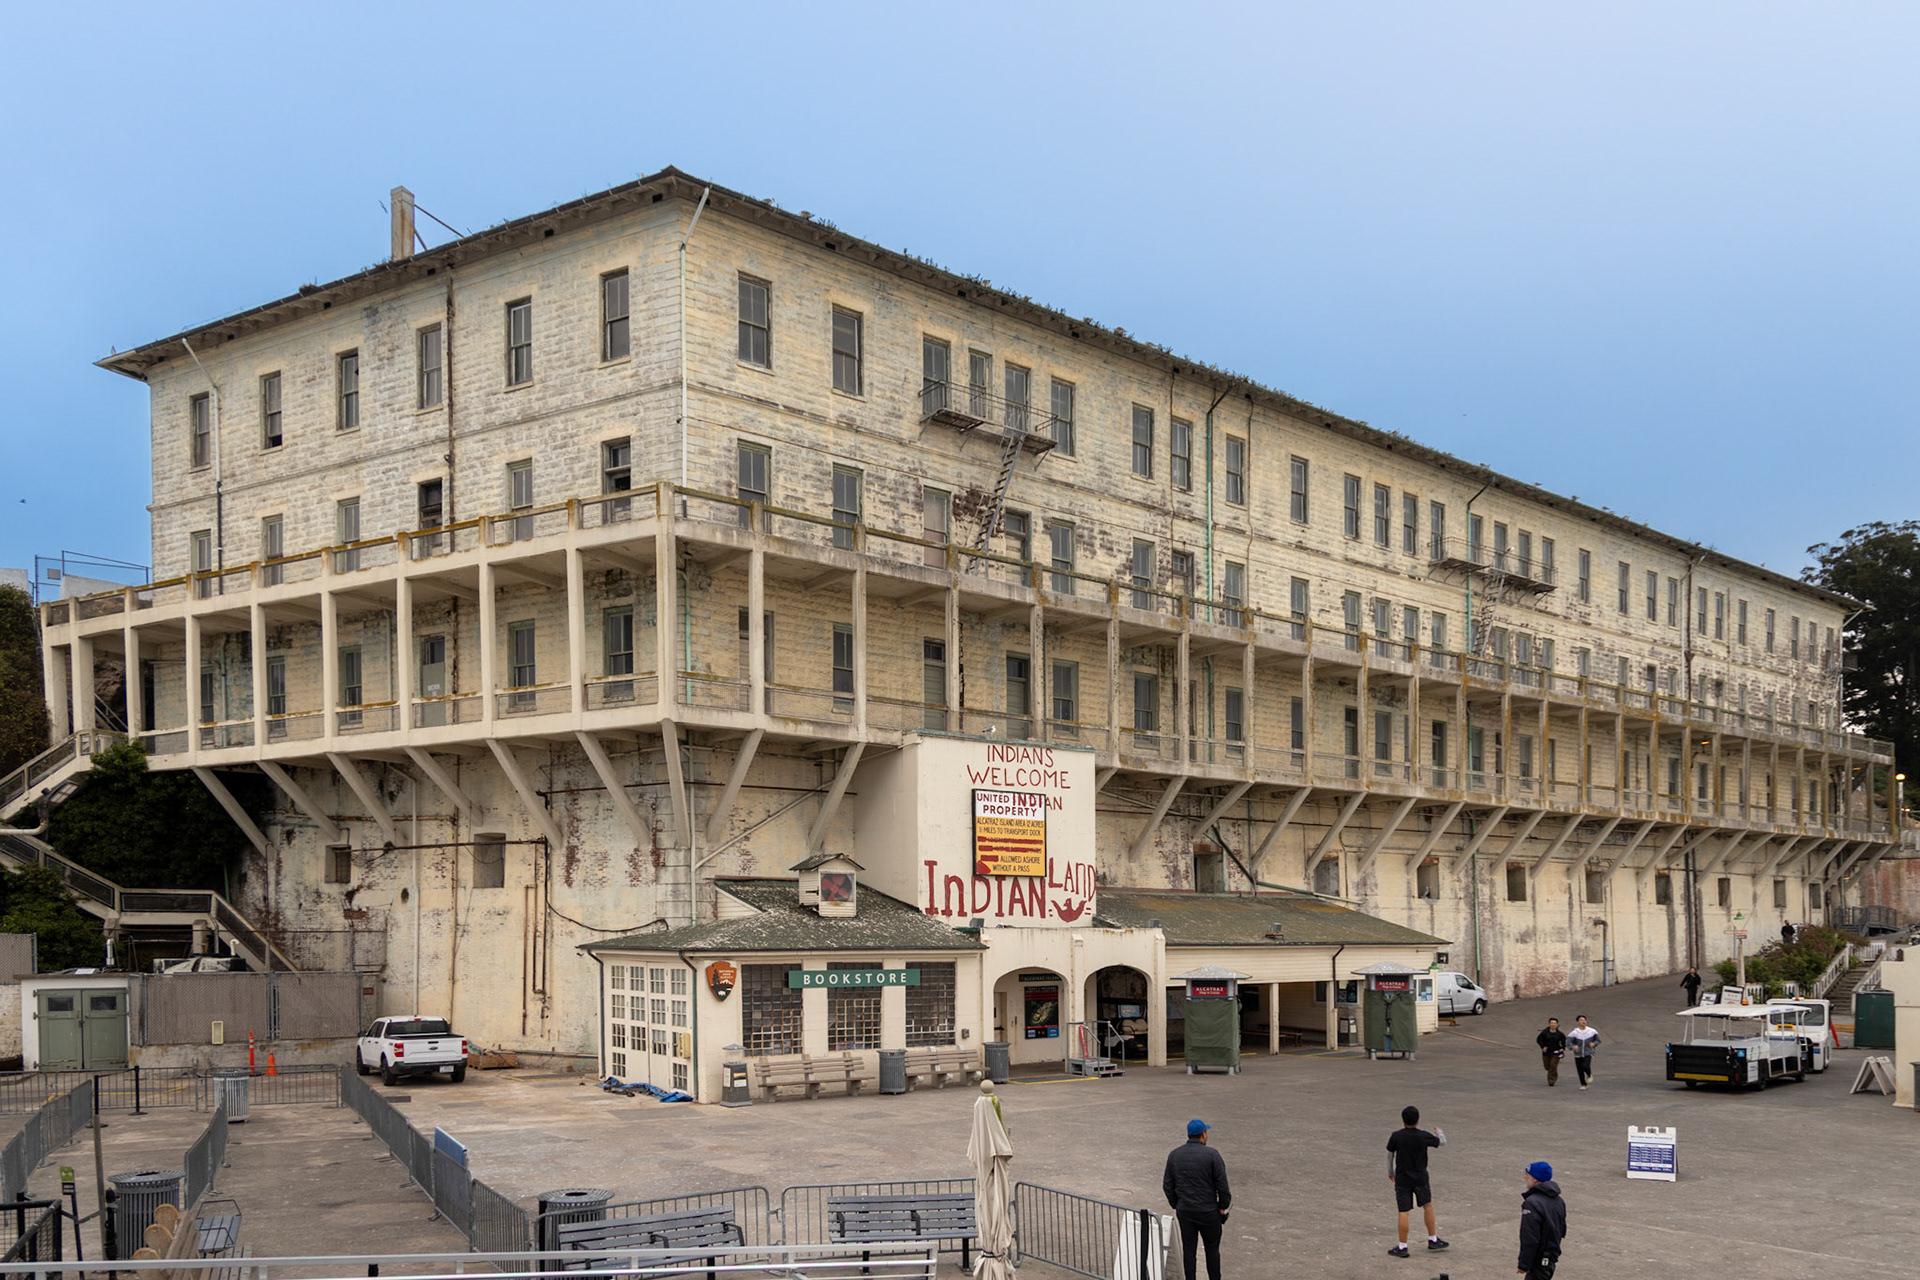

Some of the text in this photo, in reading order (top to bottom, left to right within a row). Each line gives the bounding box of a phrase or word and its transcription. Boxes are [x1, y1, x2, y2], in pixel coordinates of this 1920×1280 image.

[987, 745, 1054, 768] INDIANS
[967, 764, 1071, 789] WELCOME
[977, 793, 1010, 803] UNITED
[983, 805, 1037, 817] PROPERTY
[1030, 820, 1044, 828] ACRES
[1000, 855, 1022, 863] ALLOWED
[1023, 856, 1040, 864] ASHORE
[993, 864, 1012, 872] WITHOUT
[803, 972, 907, 985] BOOKSTORE
